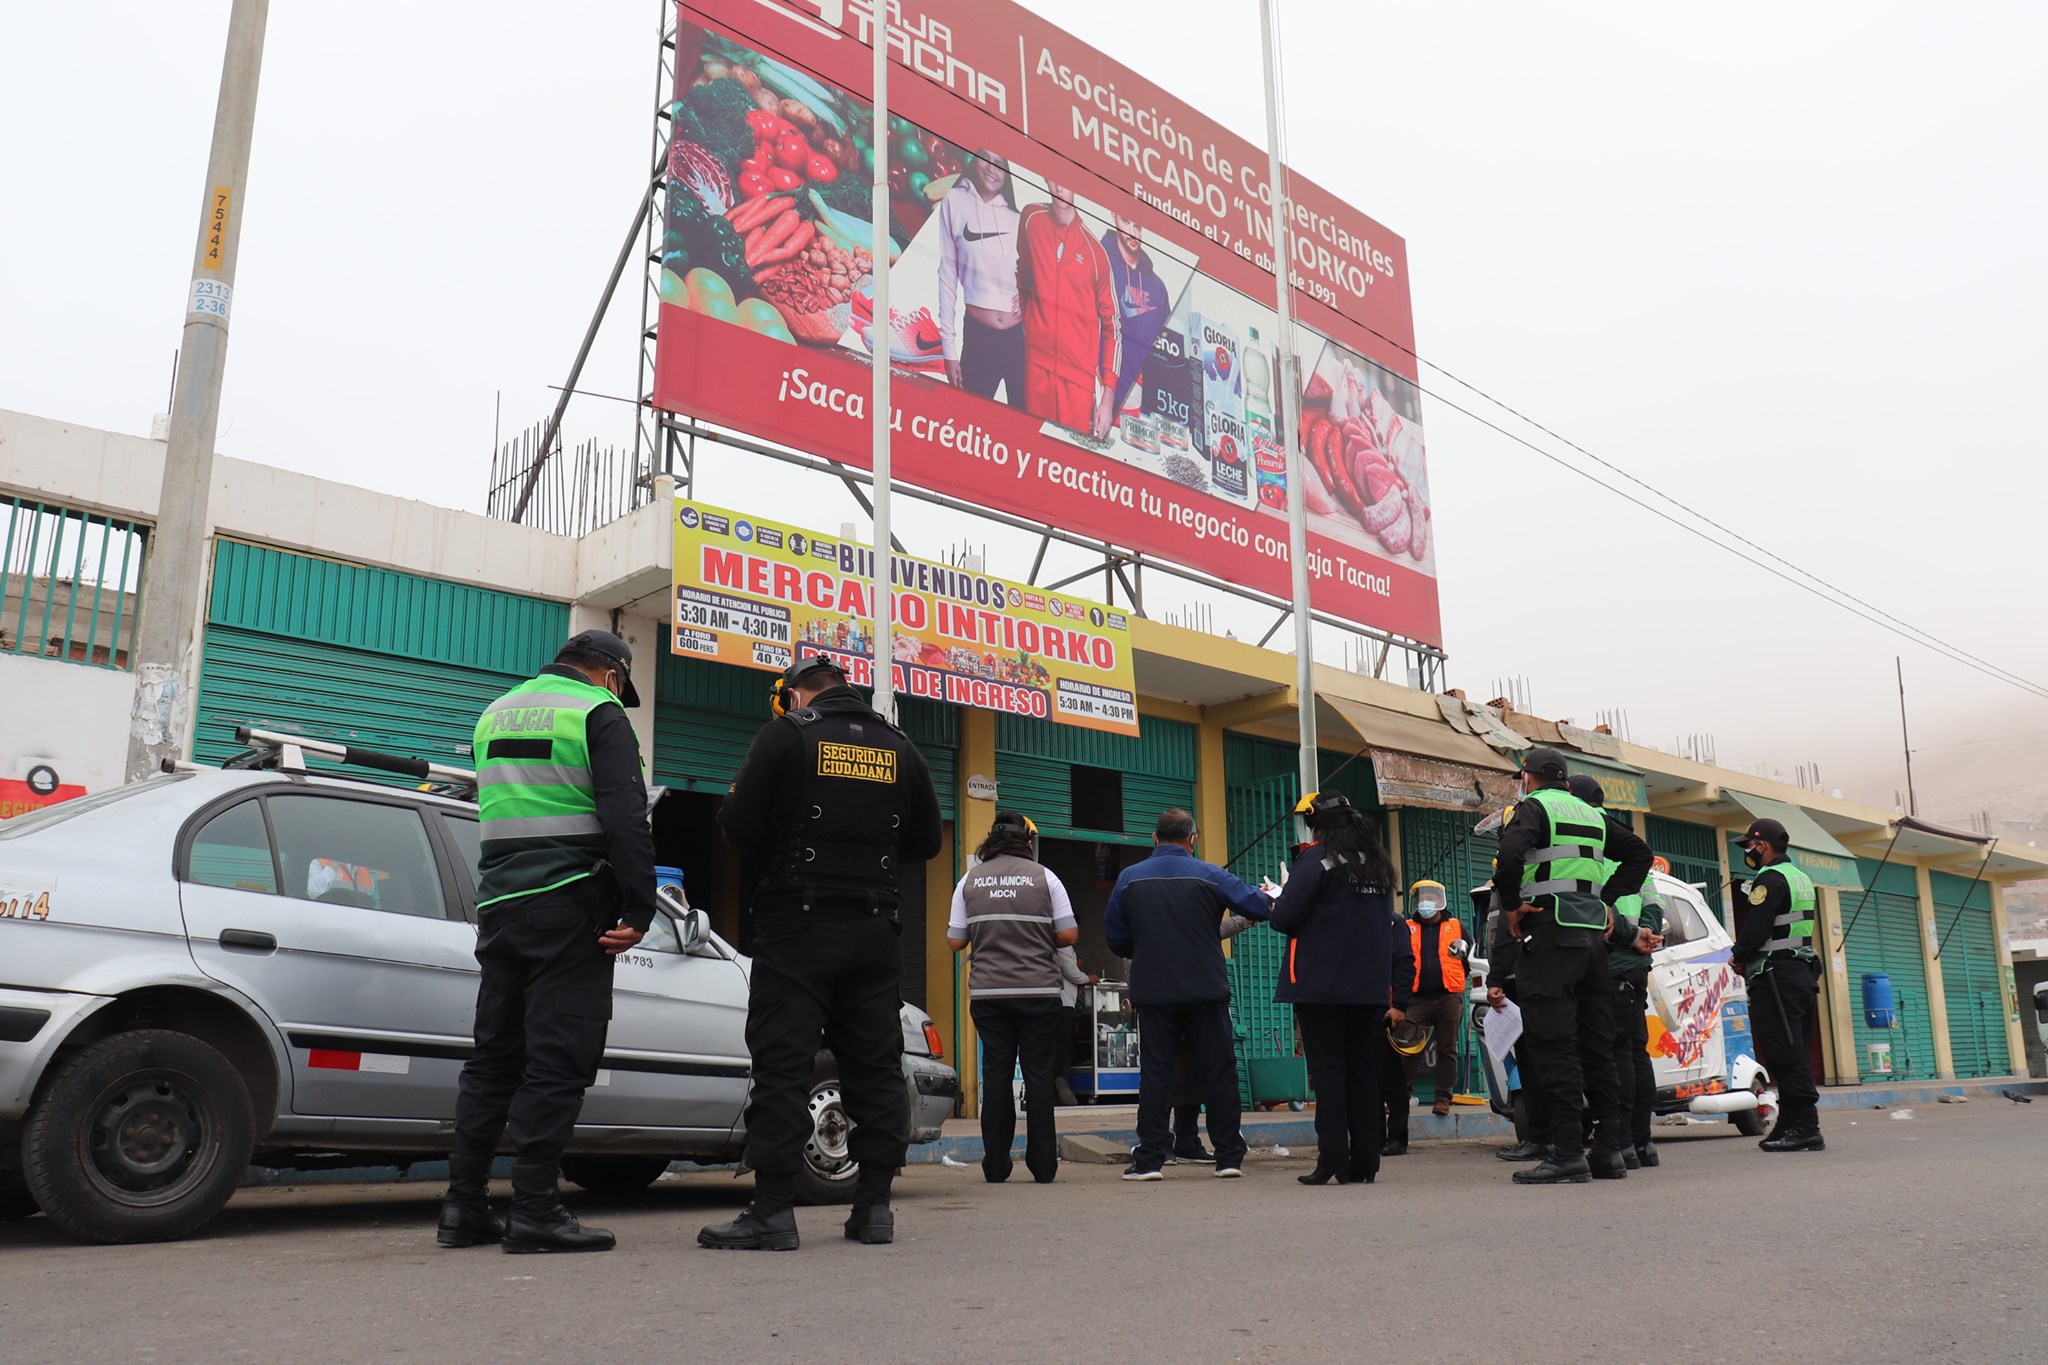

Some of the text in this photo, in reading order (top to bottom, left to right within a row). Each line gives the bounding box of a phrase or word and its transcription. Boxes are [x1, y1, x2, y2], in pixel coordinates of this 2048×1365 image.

[1036, 48, 1194, 161] Asociación
[1202, 144, 1233, 184] de
[1071, 105, 1374, 298] MERCADO “INIORKO”
[1134, 182, 1201, 232] Fundado
[1204, 220, 1219, 242] el
[1222, 230, 1231, 247] 7
[1234, 236, 1252, 261] de
[1289, 269, 1305, 291] de
[1308, 279, 1338, 309] 1991
[196, 281, 229, 300] 2313
[196, 298, 226, 315] 2-36
[1203, 325, 1237, 359] GLORIA
[1156, 389, 1189, 424] 5kg
[1125, 418, 1156, 440] PRIMOR
[1155, 416, 1185, 437] PRIMOR
[1211, 413, 1246, 447] GLORIA
[1216, 460, 1243, 482] LECHE
[778, 368, 864, 420] ¡Saca
[911, 418, 1009, 466] crédito
[1016, 448, 1031, 479] y
[1037, 456, 1134, 508] reactiva
[1140, 487, 1162, 518] tu
[1168, 501, 1249, 548] negocio
[1254, 532, 1289, 562] con
[1305, 549, 1333, 580] aja
[1337, 557, 1391, 597] Tacna!
[682, 588, 787, 619] HORARIO DE ATENCION AL PUBLICO
[681, 603, 707, 625] 5:30
[710, 609, 729, 630] AM
[742, 616, 768, 638] 4:30
[771, 621, 788, 642] PM
[679, 637, 716, 654] 600 PERS.
[691, 630, 711, 641] FORO
[936, 601, 1113, 669] INTIORKO
[756, 652, 788, 668] 40 %
[912, 669, 941, 699] DE
[948, 675, 1046, 717] INGRESO
[1060, 679, 1131, 702] HORARIO DE INGRESO
[1060, 696, 1078, 710] 5:30
[1080, 699, 1093, 713] AM
[1102, 704, 1119, 718] 4:30
[1121, 707, 1134, 720] PM
[490, 708, 555, 735] POLICIA
[823, 745, 893, 767] SEGURIDAD
[823, 760, 893, 781] CIUDADANA
[968, 781, 996, 791] ENTRADA
[1798, 851, 1841, 870] TIENDA
[974, 876, 1034, 888] POLICIA MUNICIPAL
[989, 889, 1017, 899] MDCN
